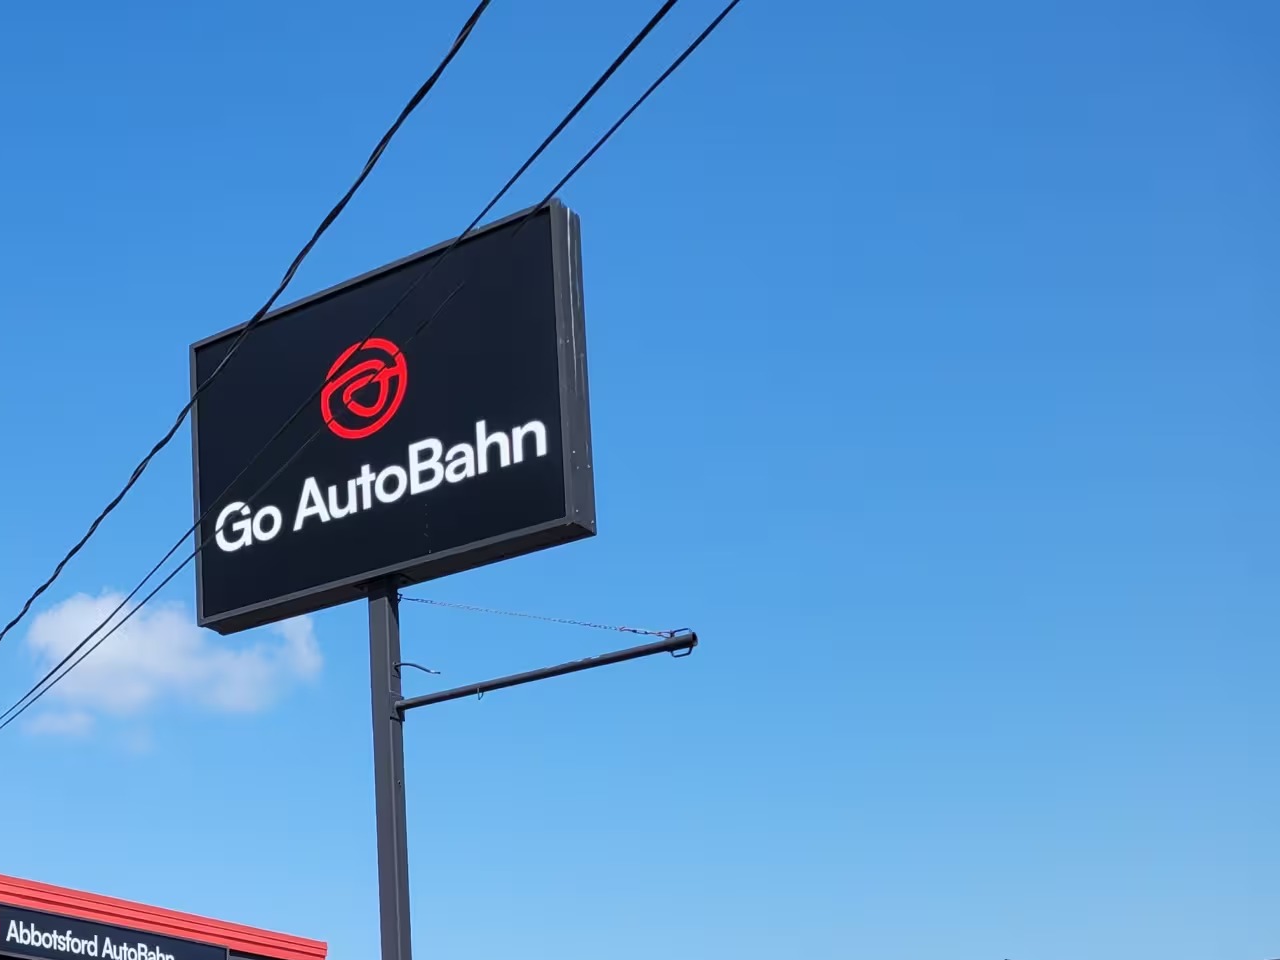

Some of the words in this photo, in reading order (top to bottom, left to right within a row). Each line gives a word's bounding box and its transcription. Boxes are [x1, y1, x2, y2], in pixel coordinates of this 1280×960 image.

[215, 501, 282, 552] Go
[293, 419, 547, 532] AutoBahn
[6, 919, 99, 957] Abbotsford
